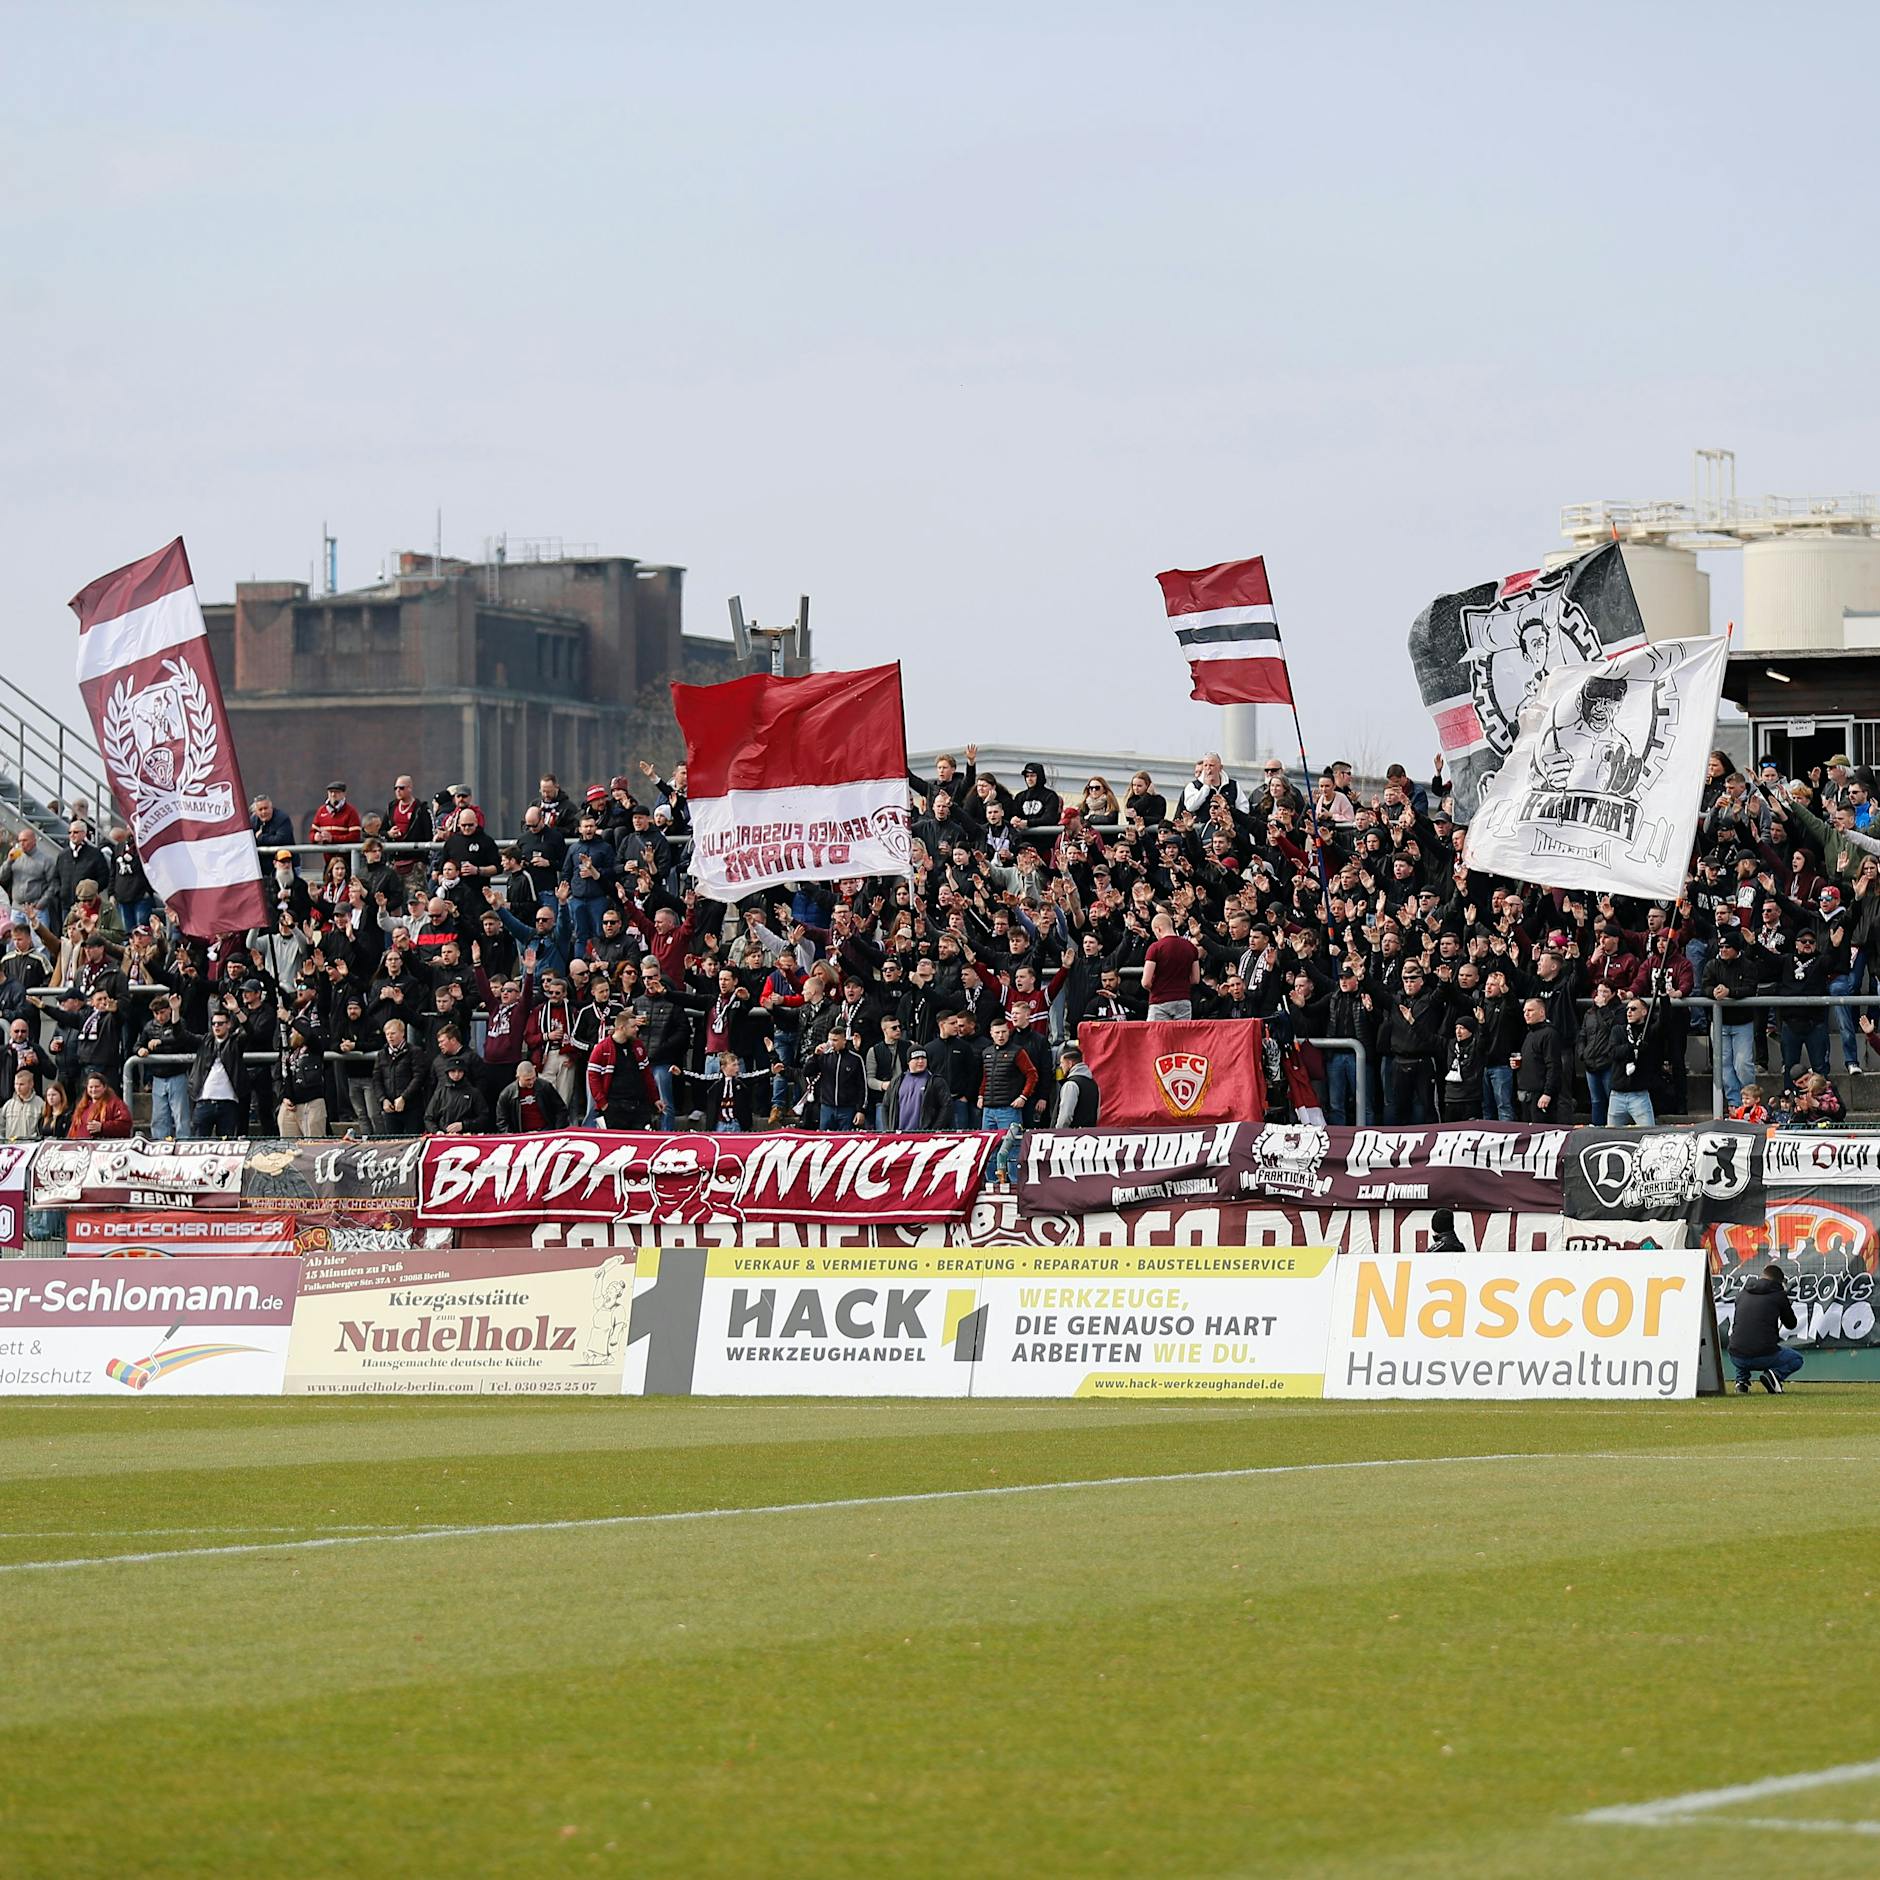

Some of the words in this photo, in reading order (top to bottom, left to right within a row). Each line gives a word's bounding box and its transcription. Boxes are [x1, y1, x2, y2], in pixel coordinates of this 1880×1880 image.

[1158, 1055, 1205, 1075] BFC
[178, 1142, 249, 1155] FAMILIE
[1025, 1121, 1242, 1185] FRAKTION-H
[1344, 1129, 1429, 1178] OST
[1425, 1128, 1573, 1181] BERLIN
[1766, 1141, 1801, 1173] FICK
[1807, 1141, 1871, 1172] DICH
[424, 1137, 638, 1209] BANDA
[738, 1137, 984, 1204] INVICTA
[1257, 1169, 1315, 1191] FRAKTION-H
[129, 1190, 194, 1208] BERLIN
[1111, 1184, 1166, 1206] BERLINER
[1165, 1177, 1219, 1198] FUSSBALL
[1356, 1184, 1387, 1200] CLUB
[1386, 1181, 1429, 1202] DYNAMO
[75, 1222, 91, 1236] 10
[103, 1222, 209, 1237] DEUTSCHER
[210, 1221, 284, 1237] MEISTER
[1724, 1212, 1857, 1260] BFC
[305, 1270, 318, 1280] 15
[319, 1266, 364, 1279] Minuten
[365, 1266, 380, 1275] zu
[380, 1262, 404, 1273] Fuß
[306, 1255, 322, 1267] Ab
[323, 1255, 347, 1266] hier
[734, 1259, 801, 1271] VERKAUF
[806, 1259, 816, 1271] &
[822, 1259, 919, 1271] VERMIETUNG
[937, 1258, 1016, 1271] BERATUNG
[1033, 1258, 1119, 1271] REPARATUR
[1137, 1258, 1296, 1271] BAUSTELLENSERVICE
[303, 1278, 360, 1292] Falkenberger
[360, 1277, 374, 1287] Str.
[375, 1277, 391, 1285] 37A
[423, 1271, 450, 1281] Berlin
[388, 1290, 530, 1311] Kiezgaststätte
[1018, 1287, 1189, 1312] WERKZEUGE,
[1351, 1260, 1686, 1339] Nascor
[727, 1288, 931, 1339] HACK
[333, 1315, 577, 1353] Nudelholz
[1015, 1315, 1057, 1336] DIE
[1067, 1315, 1195, 1336] GENAUSO
[1204, 1315, 1277, 1336] HART
[30, 1339, 43, 1356] &
[726, 1346, 926, 1363] WERKZEUGHANDEL
[1011, 1342, 1142, 1363] ARBEITEN
[1152, 1342, 1202, 1363] WIE
[1212, 1342, 1256, 1364] DU.
[361, 1357, 449, 1370] Hausgemachte
[450, 1356, 502, 1369] deutsche
[504, 1355, 543, 1368] Küche
[1347, 1350, 1679, 1396] Hausverwaltung
[306, 1380, 474, 1393] www.nudelholz-berlin.com
[488, 1381, 512, 1392] Tel.
[514, 1381, 537, 1392] 030
[538, 1381, 562, 1392] 925
[563, 1381, 579, 1392] 25
[581, 1381, 598, 1392] 07
[1094, 1378, 1284, 1392] www.hack-werkzeughandel.de
